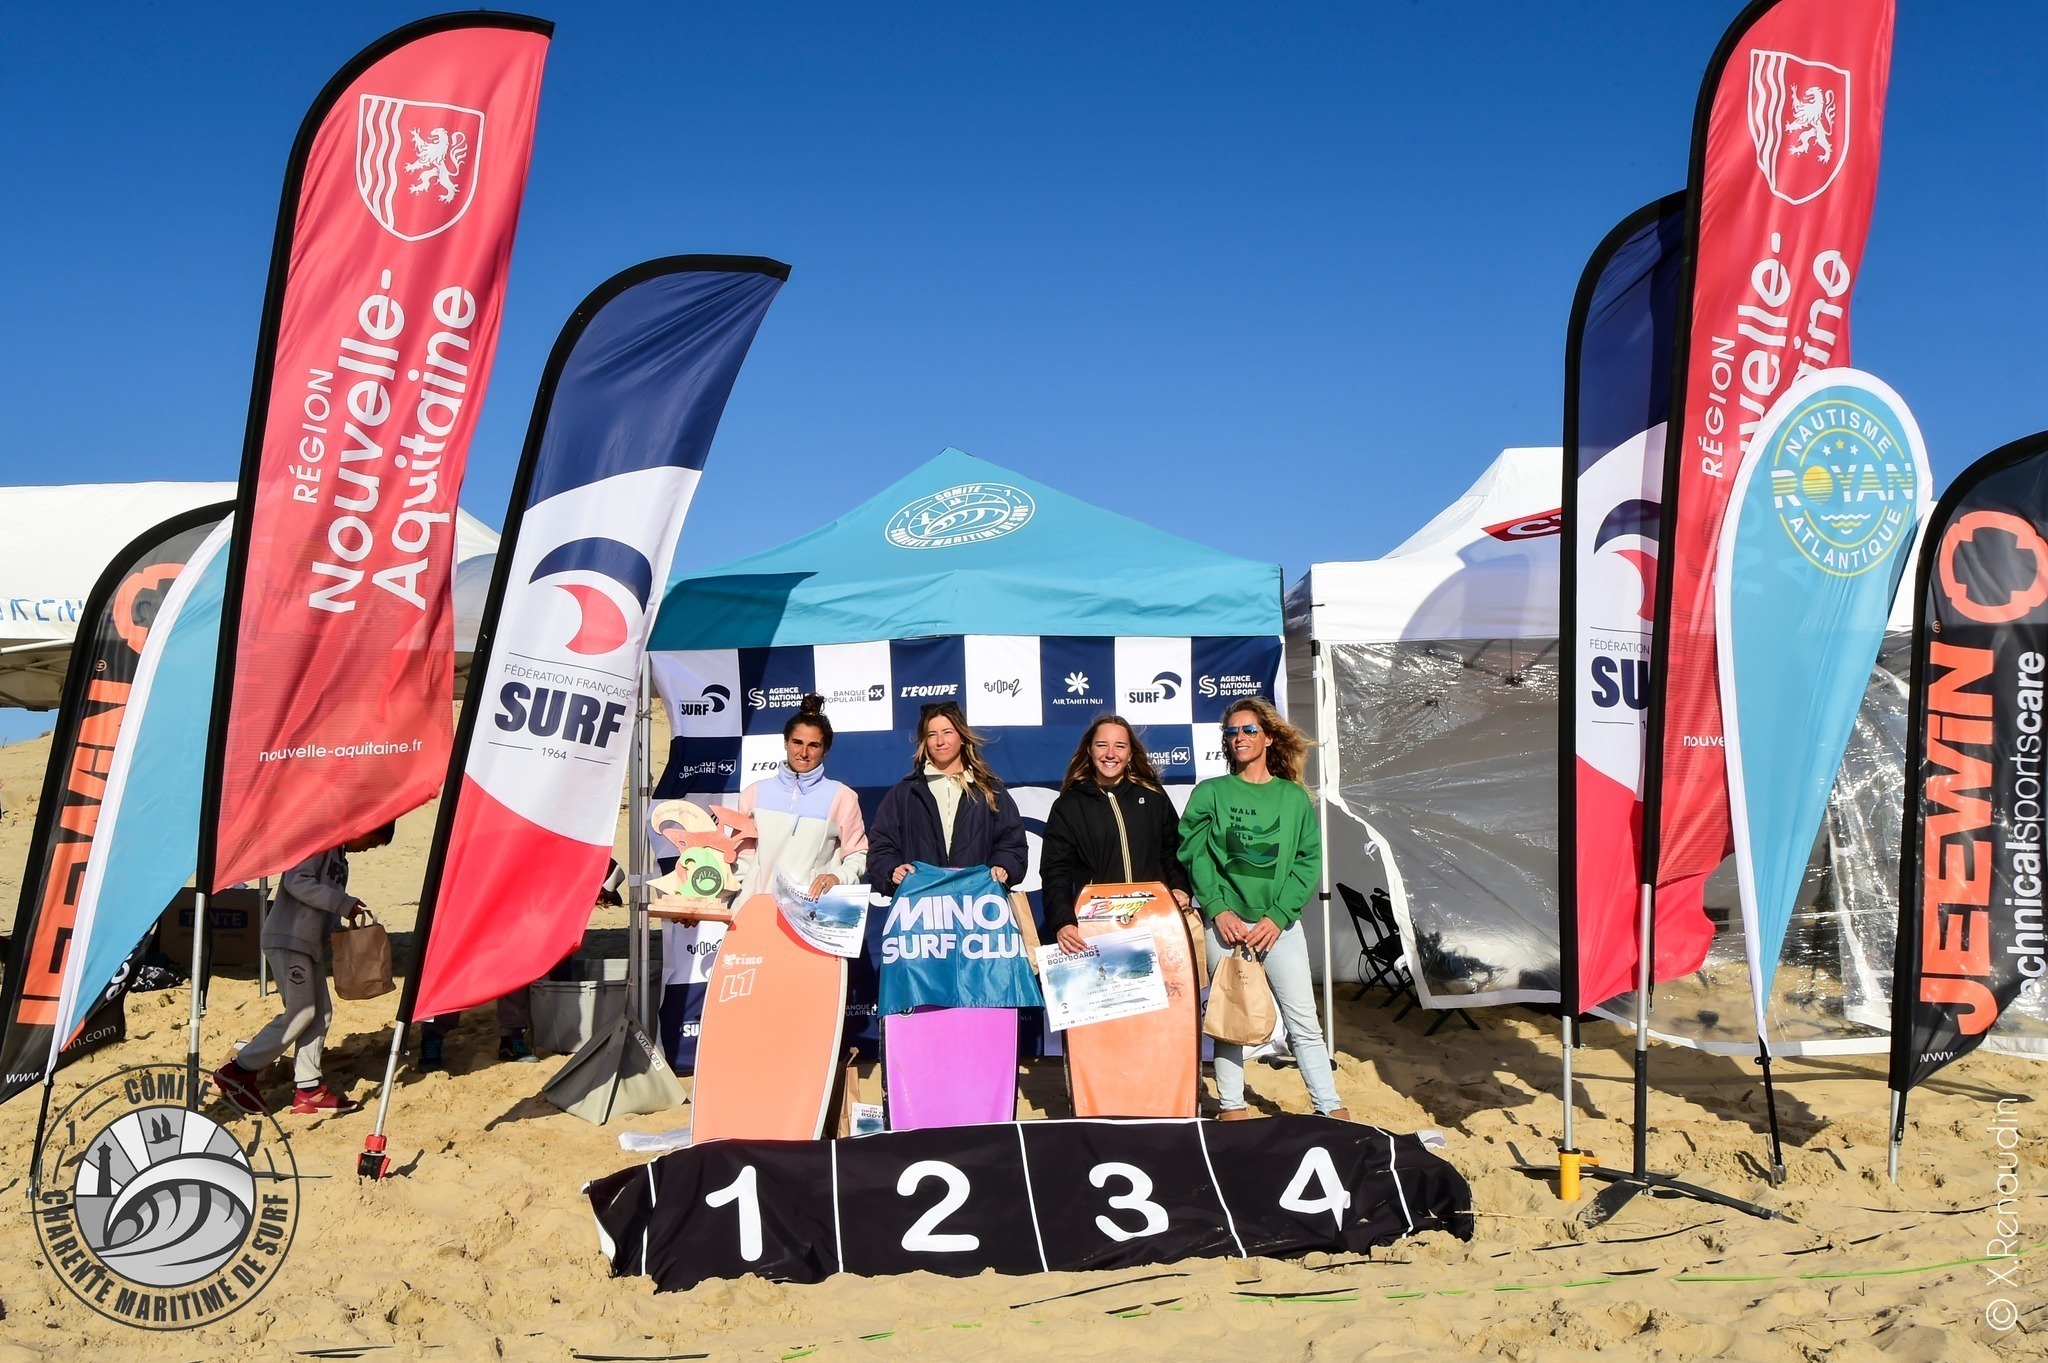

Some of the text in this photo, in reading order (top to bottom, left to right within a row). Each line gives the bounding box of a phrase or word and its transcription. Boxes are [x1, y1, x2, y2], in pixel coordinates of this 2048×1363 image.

[1698, 336, 1736, 478] RÉGION
[288, 368, 334, 504] RÉGION
[308, 268, 405, 614] Nouvelle-
[371, 286, 477, 611] Aquitaine
[1785, 408, 1891, 458] NAUTISME
[1789, 508, 1902, 570] ATLANTIQUE
[1589, 639, 1650, 654] FÉDÉRATION
[504, 663, 632, 700] FÉDÉRATION FRANÇAISE
[833, 689, 867, 697] BANQUE
[900, 683, 959, 698] L'ÉQUIPE
[1129, 691, 1160, 704] SURF
[1232, 688, 1258, 696] SPORT
[1591, 656, 1650, 710] SU
[494, 681, 627, 749] SURF
[681, 703, 709, 716] SURF
[259, 739, 423, 762] nouvelle-aquitaine.fr
[541, 747, 568, 760] 1964
[1229, 806, 1257, 815] WALK
[882, 934, 956, 965] SURF
[705, 1164, 763, 1262] 1
[895, 1159, 981, 1253] 2
[1087, 1161, 1170, 1243] 3
[1277, 1146, 1352, 1233] 4
